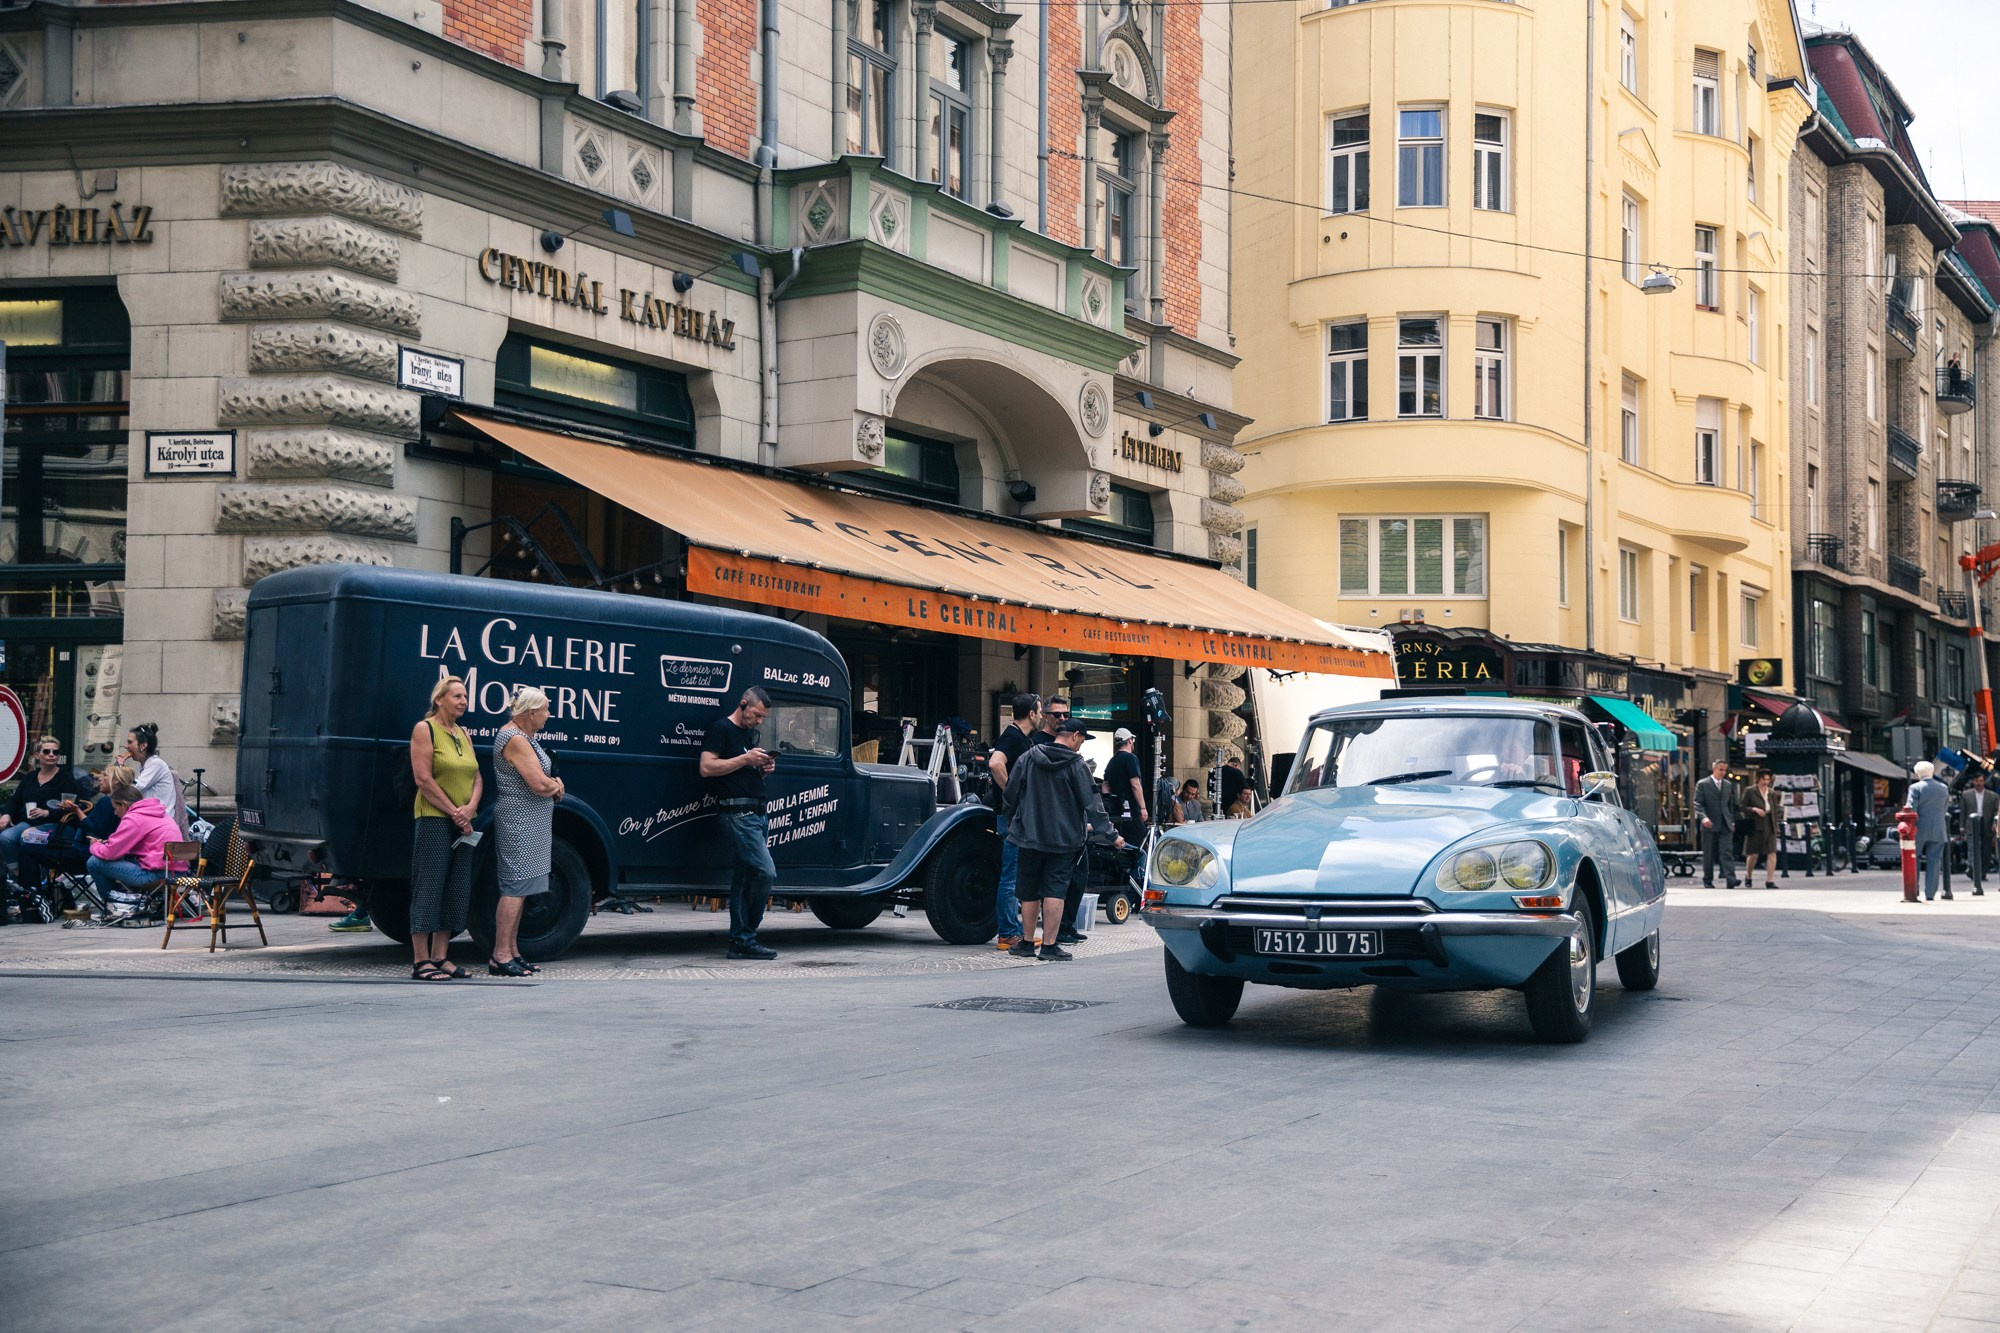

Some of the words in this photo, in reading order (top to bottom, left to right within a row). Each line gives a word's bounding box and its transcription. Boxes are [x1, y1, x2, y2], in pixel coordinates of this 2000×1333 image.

[478, 247, 608, 315] CENTRÁL
[620, 288, 736, 351] KÁVÉHÁZ
[411, 361, 432, 381] Irányi
[437, 369, 452, 382] utca
[157, 446, 197, 464] Károlyi
[200, 447, 224, 460] utca
[1121, 430, 1183, 473] ÉTTEREM
[715, 567, 743, 584] CAFÉ
[749, 573, 822, 598] RESTAURANT
[908, 597, 928, 619] LE
[940, 603, 1017, 633] CENTRAL
[420, 624, 467, 661] LA
[481, 618, 636, 675] GALERIE
[1104, 630, 1150, 645] RESTAURANT
[1202, 639, 1216, 655] LE
[1222, 641, 1273, 661] CENTRAL
[1394, 642, 1443, 657] ERNST
[665, 660, 678, 675] Le
[679, 661, 711, 674] dernier
[711, 666, 725, 677] cri,
[680, 673, 698, 685] c'est
[763, 667, 798, 684] BALZAC
[802, 673, 831, 688] 28-40
[1395, 658, 1491, 679] LÉRIA
[668, 693, 687, 703] MÉTRO
[687, 695, 720, 707] MIROMESNIL
[479, 727, 490, 737] de
[533, 731, 568, 742] eydeville
[584, 734, 607, 744] PARIS
[675, 722, 706, 736] Ouvertur
[660, 734, 670, 744] du
[670, 736, 692, 746] mardi
[766, 798, 785, 815] OUR
[786, 794, 797, 809] LA
[798, 784, 830, 805] FEMME
[618, 816, 642, 836] On
[641, 816, 655, 837] y
[656, 800, 701, 824] trouve
[768, 813, 793, 831] MME,
[799, 798, 839, 823] L'ENFANT
[766, 834, 778, 848] ET
[779, 831, 791, 845] LA
[791, 820, 826, 842] MAISON
[1262, 931, 1306, 953] 7512
[1314, 933, 1337, 954] JU
[1347, 933, 1370, 954] 75
